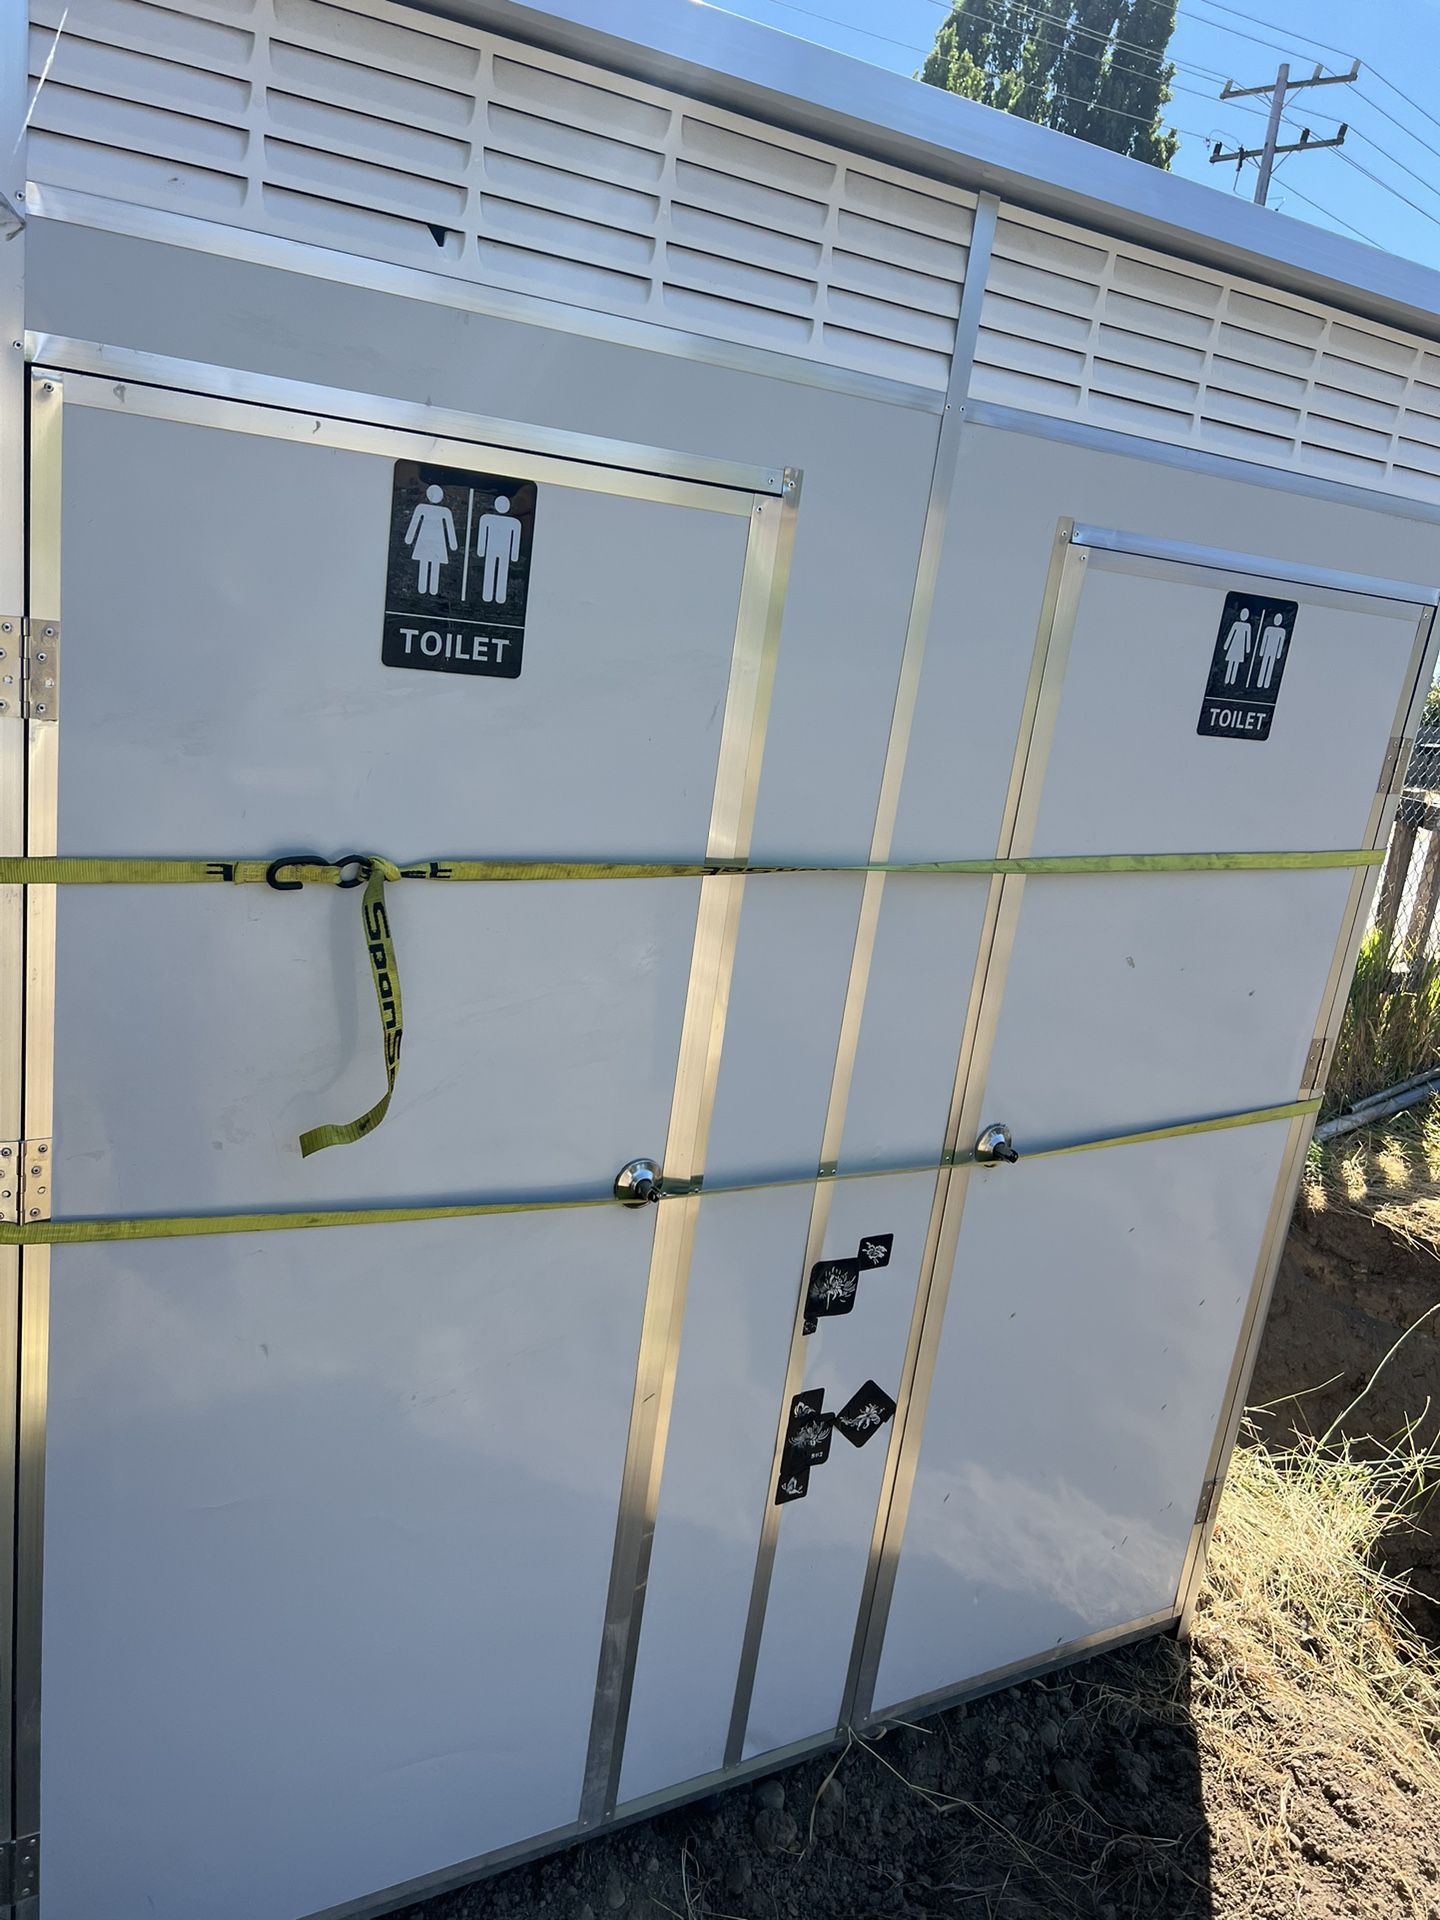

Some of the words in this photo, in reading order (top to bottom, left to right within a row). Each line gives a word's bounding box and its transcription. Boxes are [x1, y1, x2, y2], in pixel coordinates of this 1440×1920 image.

[400, 628, 510, 663] TOILET
[1210, 708, 1267, 731] TOILET
[364, 901, 403, 1093] SpanS
